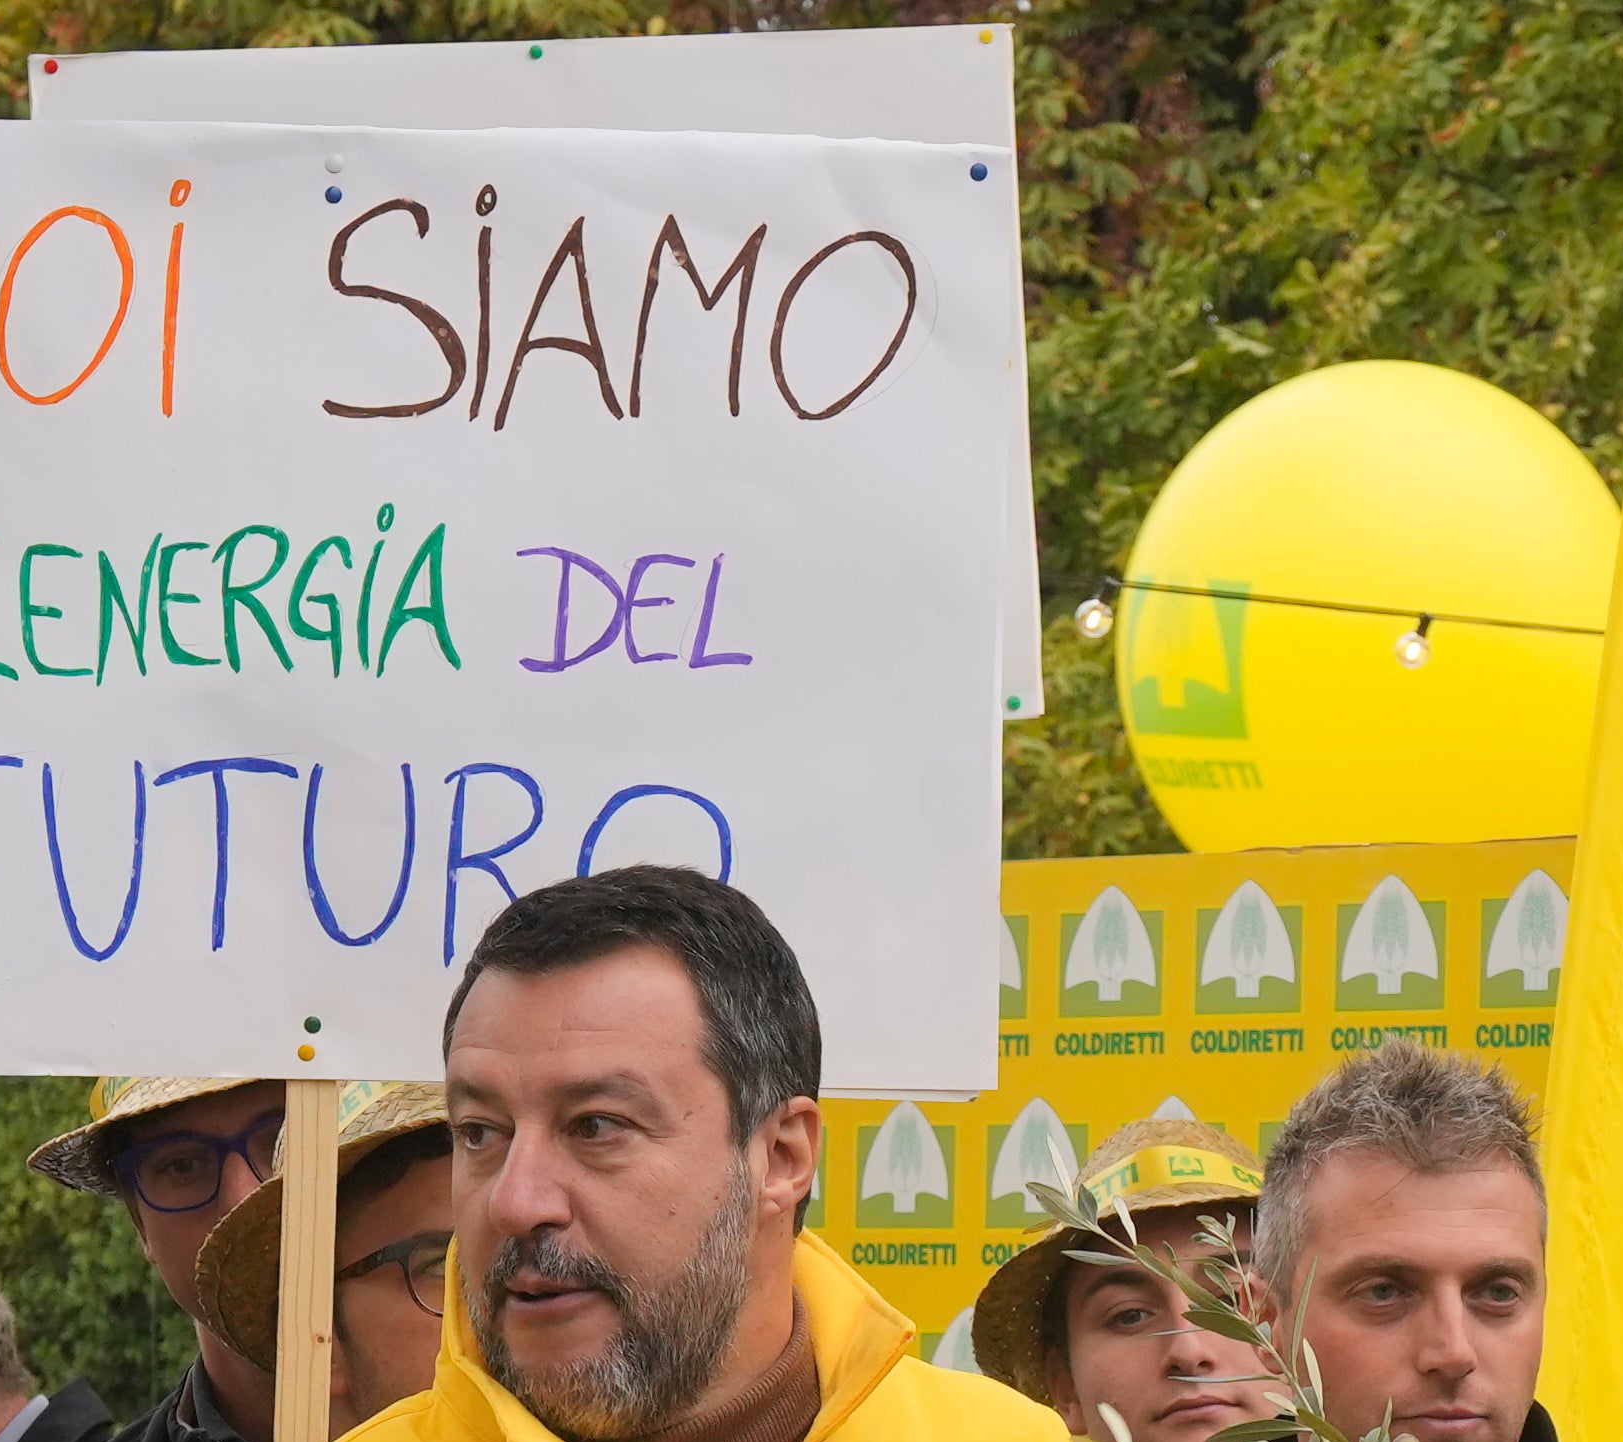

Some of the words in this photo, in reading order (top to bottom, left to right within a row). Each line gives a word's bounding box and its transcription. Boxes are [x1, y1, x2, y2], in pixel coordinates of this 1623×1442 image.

[322, 183, 917, 432] SIAMO
[516, 549, 754, 674] DEL
[1054, 1032, 1166, 1056] COLDIRETTI
[1190, 1029, 1305, 1054] COLDIRETTI
[1475, 1025, 1553, 1050] COLDIR
[852, 1242, 957, 1266] COLDIRETTI
